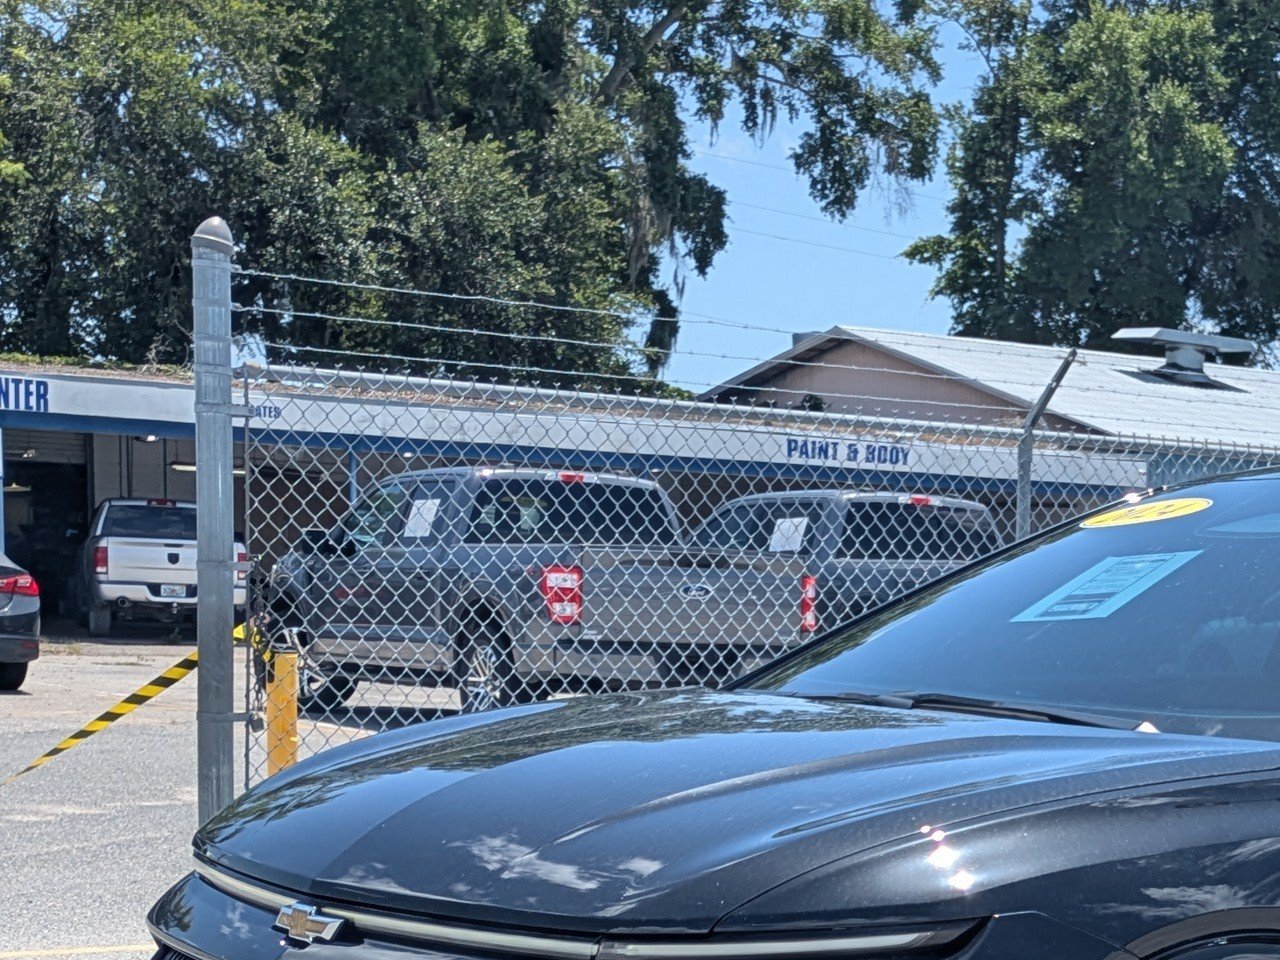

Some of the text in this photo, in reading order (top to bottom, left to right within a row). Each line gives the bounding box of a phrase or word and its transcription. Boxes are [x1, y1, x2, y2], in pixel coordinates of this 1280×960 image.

[786, 438, 910, 466] PAINT & BODY
